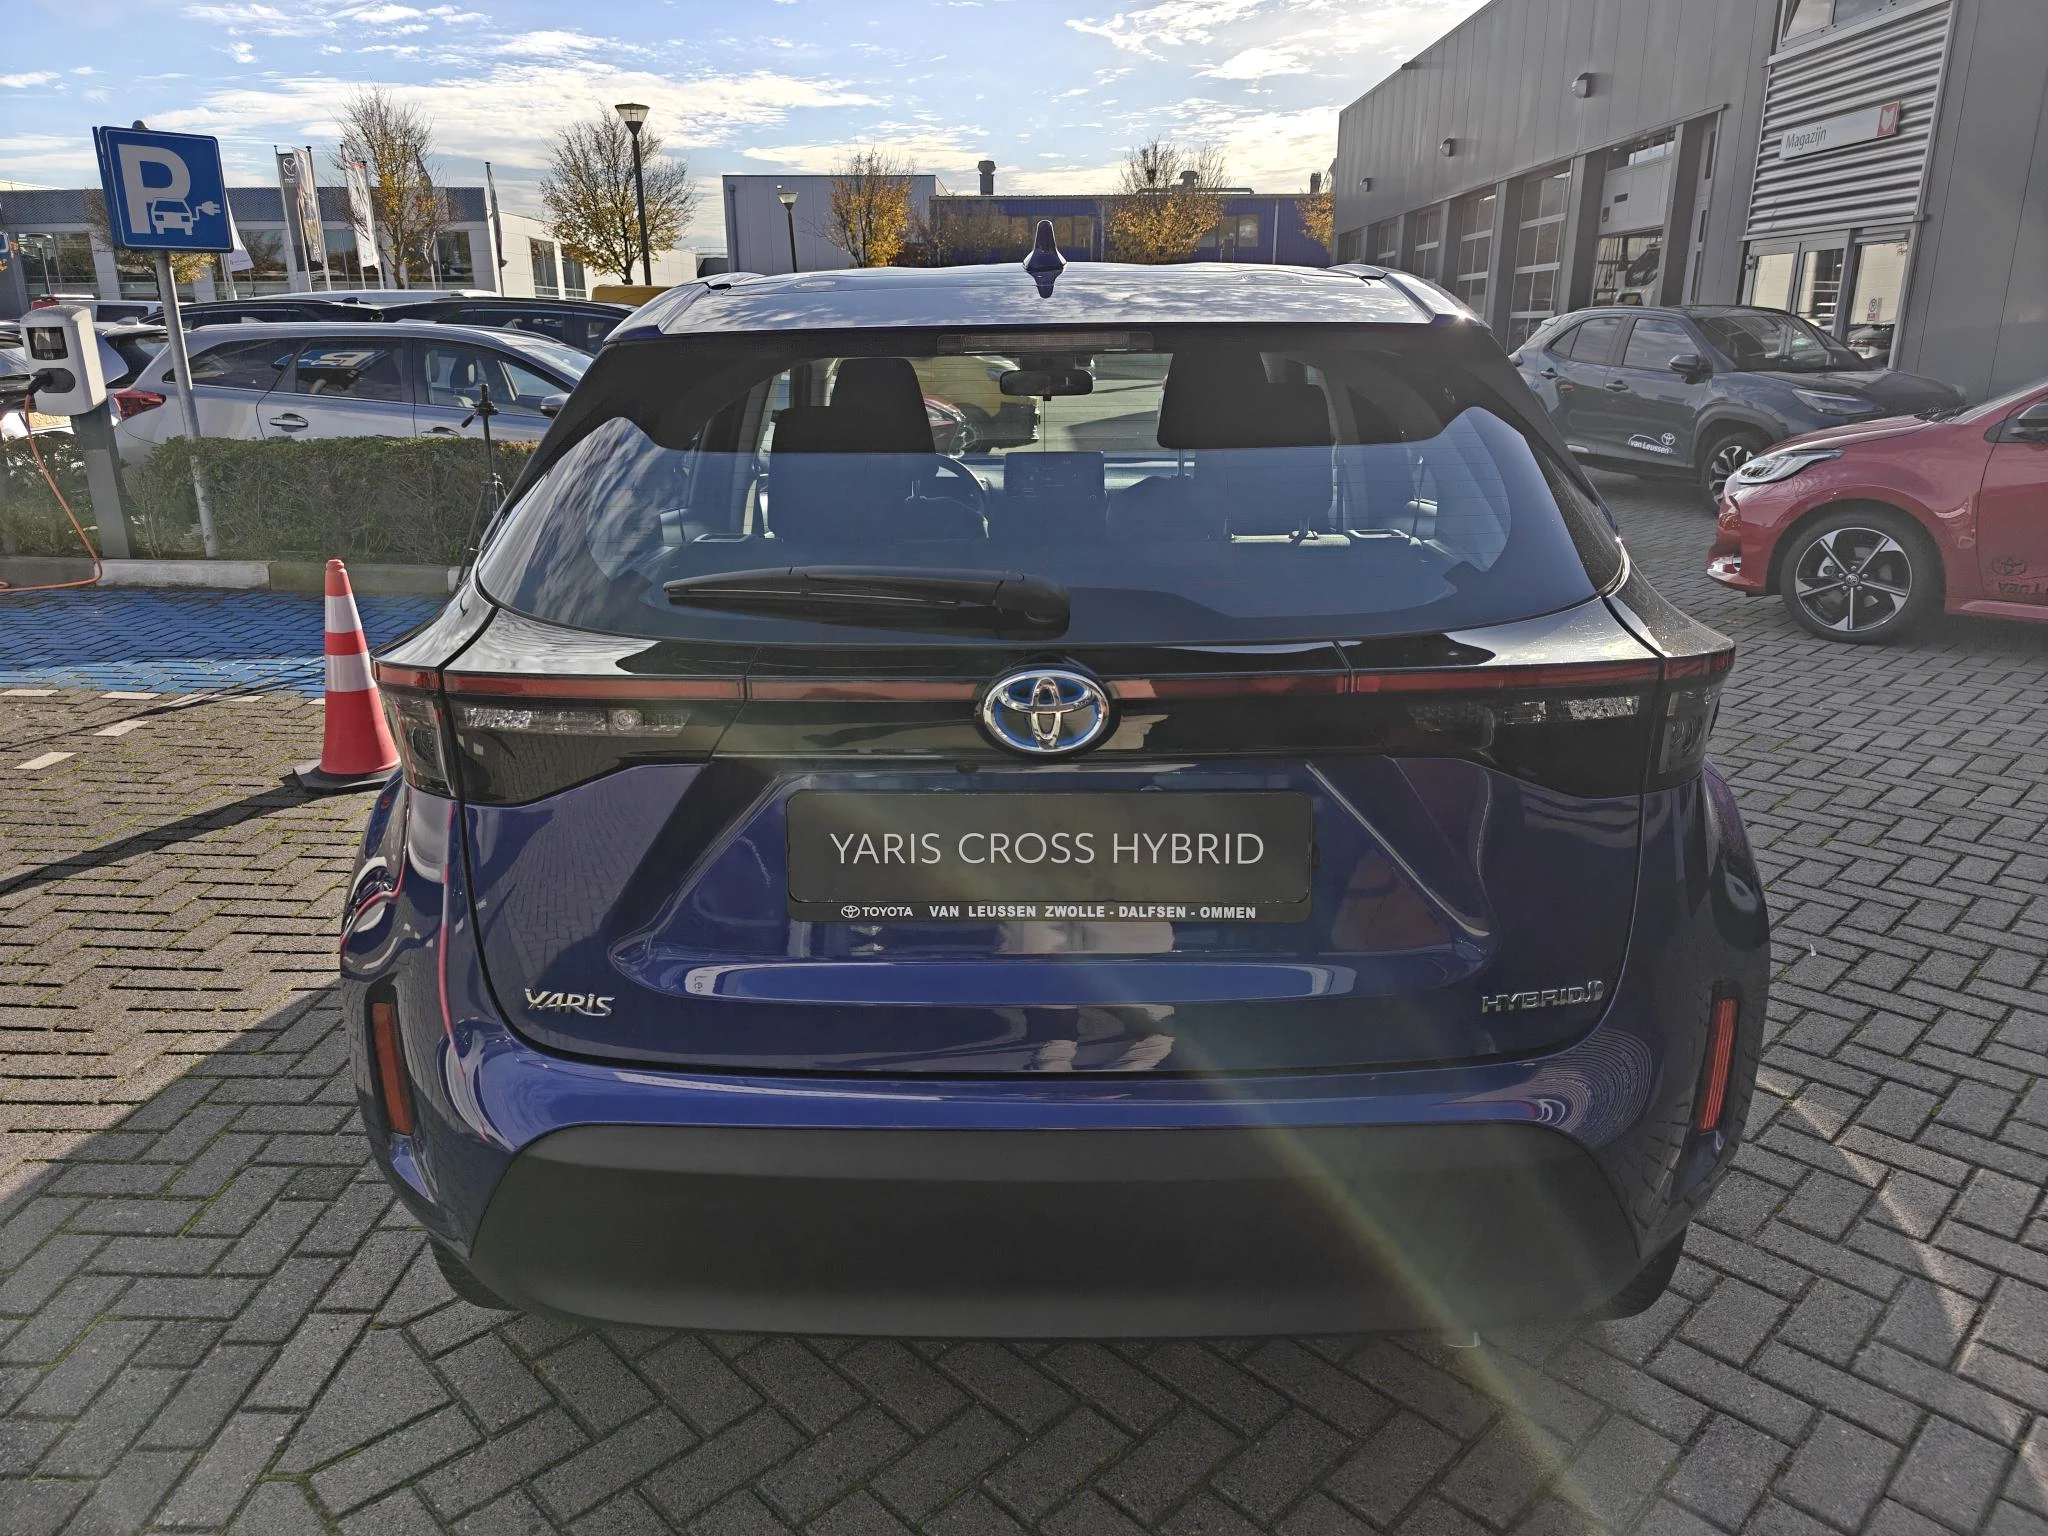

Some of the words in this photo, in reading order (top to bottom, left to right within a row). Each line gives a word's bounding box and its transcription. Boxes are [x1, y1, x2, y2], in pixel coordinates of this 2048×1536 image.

[1786, 127, 1827, 150] Magazijn
[117, 143, 191, 234] P
[1630, 439, 1642, 448] van
[1642, 441, 1669, 454] Leussen
[830, 833, 942, 864] YARIS
[958, 833, 1095, 864] CROSS
[1114, 833, 1264, 864] HYBRID
[862, 906, 914, 918] TOYOTA
[929, 905, 960, 918] VAN
[969, 905, 1037, 918] LEUSSEN
[1045, 905, 1105, 918] ZWOLLE
[1119, 905, 1186, 919] DALFSEN
[1200, 906, 1256, 919] OMMEN
[1481, 986, 1586, 1013] HYBRID
